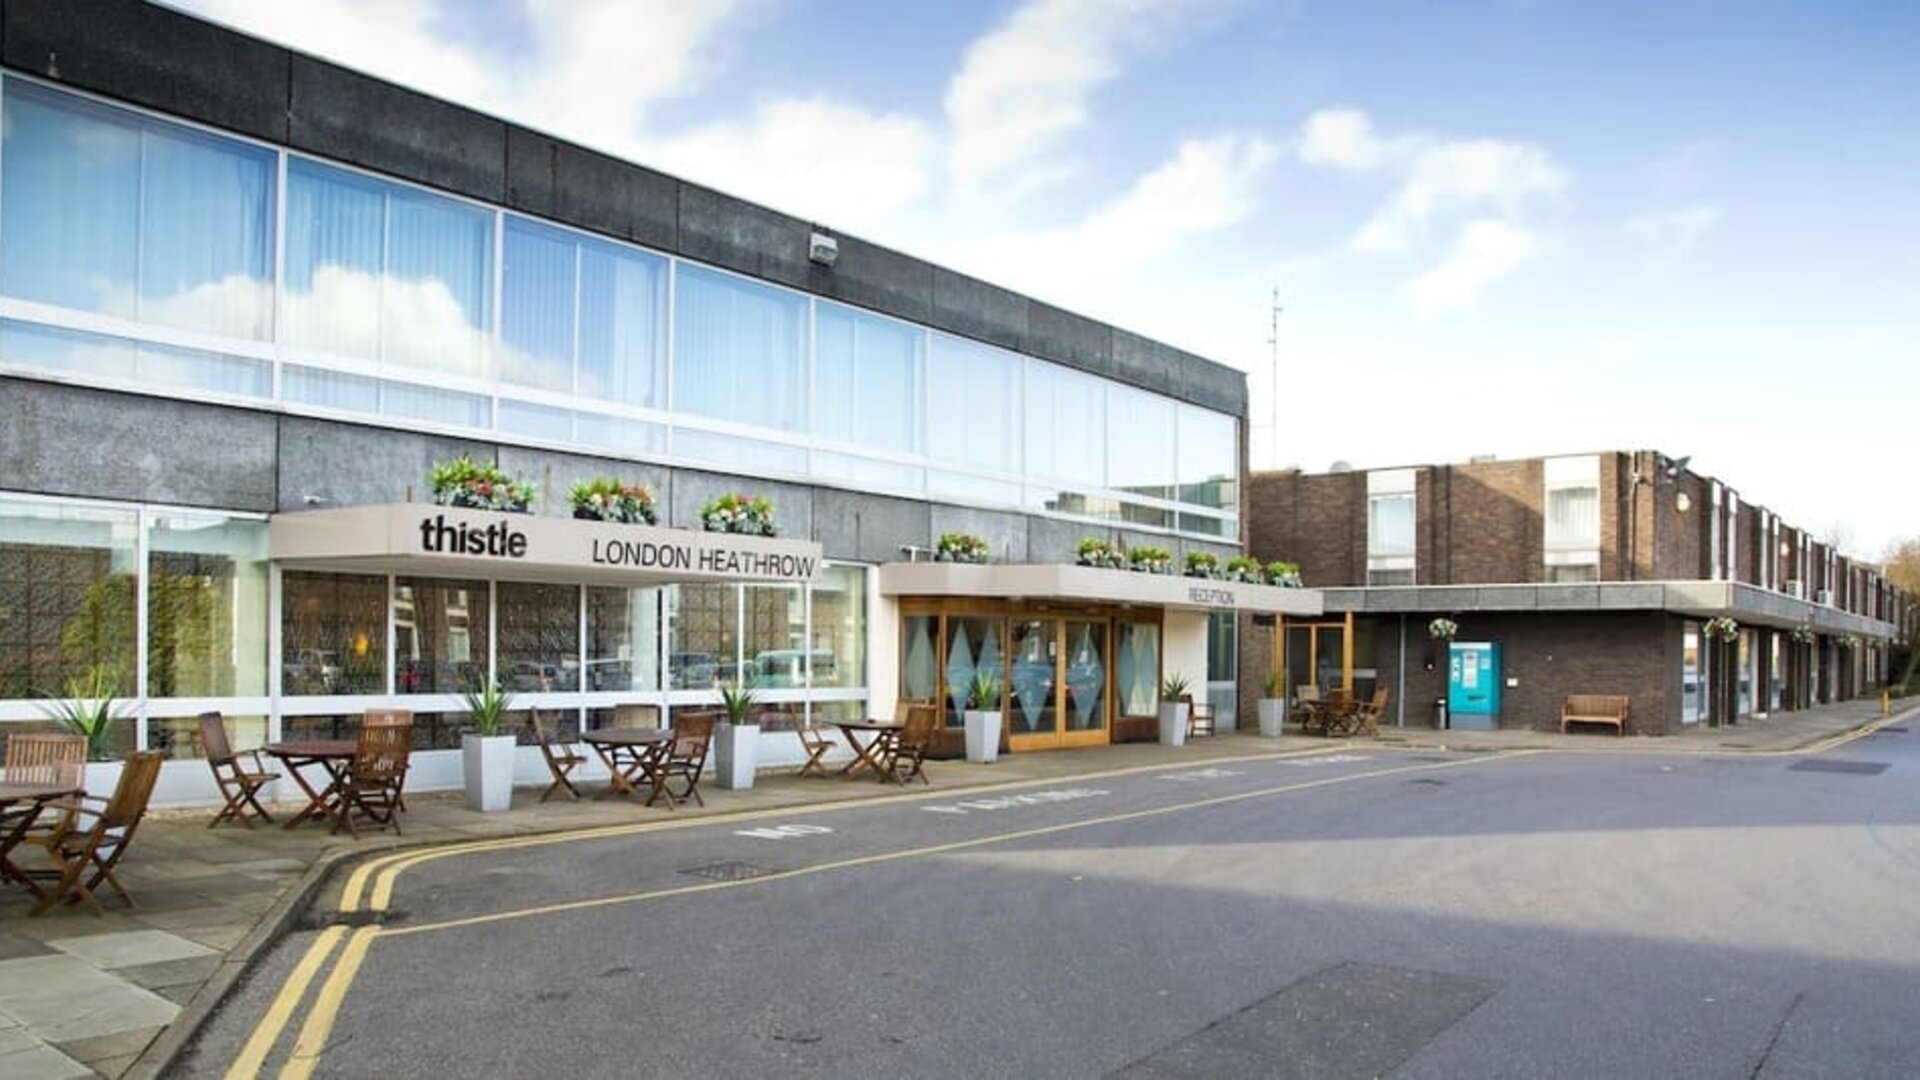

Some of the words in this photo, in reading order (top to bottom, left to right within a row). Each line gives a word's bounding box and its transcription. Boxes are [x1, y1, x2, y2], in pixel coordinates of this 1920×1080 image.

[420, 515, 528, 557] thistle
[592, 539, 692, 569] LONDON
[699, 549, 815, 578] HEATHROW
